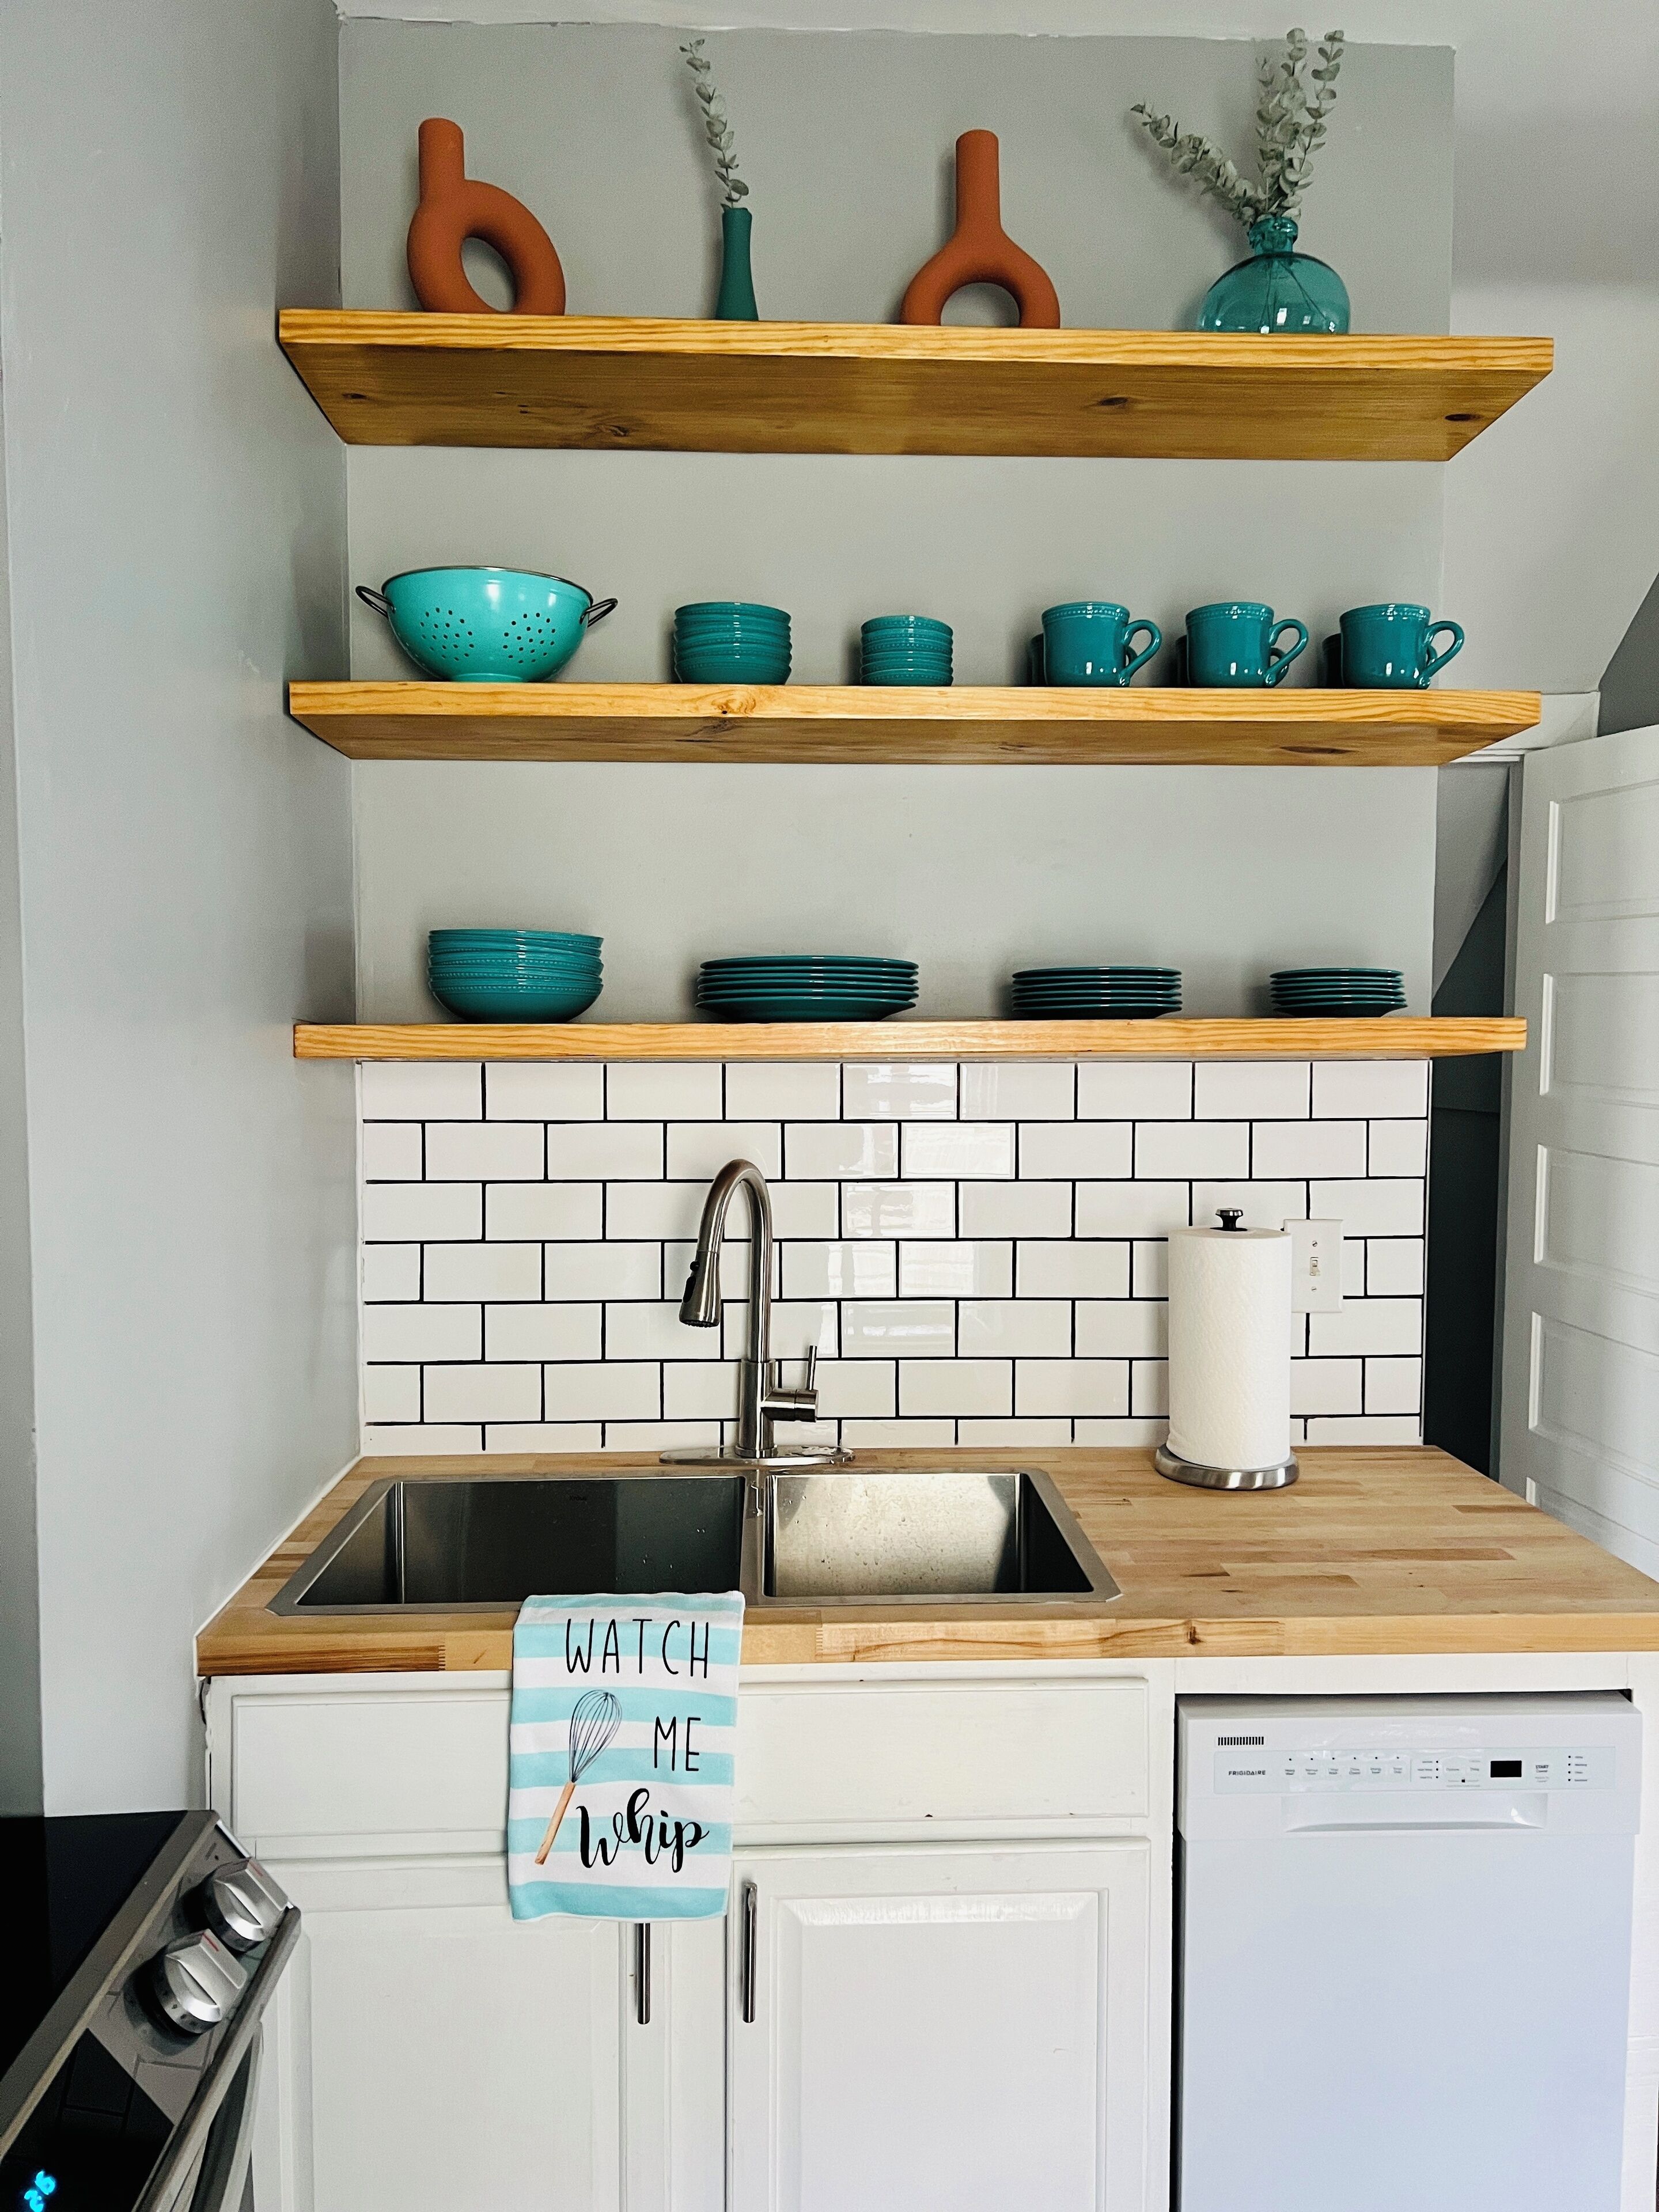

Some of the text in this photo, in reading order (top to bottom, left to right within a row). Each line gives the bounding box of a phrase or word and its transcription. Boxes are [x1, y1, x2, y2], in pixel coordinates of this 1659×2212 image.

[566, 1618, 709, 1679] WATCH
[654, 1716, 702, 1772] ME
[575, 1788, 710, 1873] Whip
